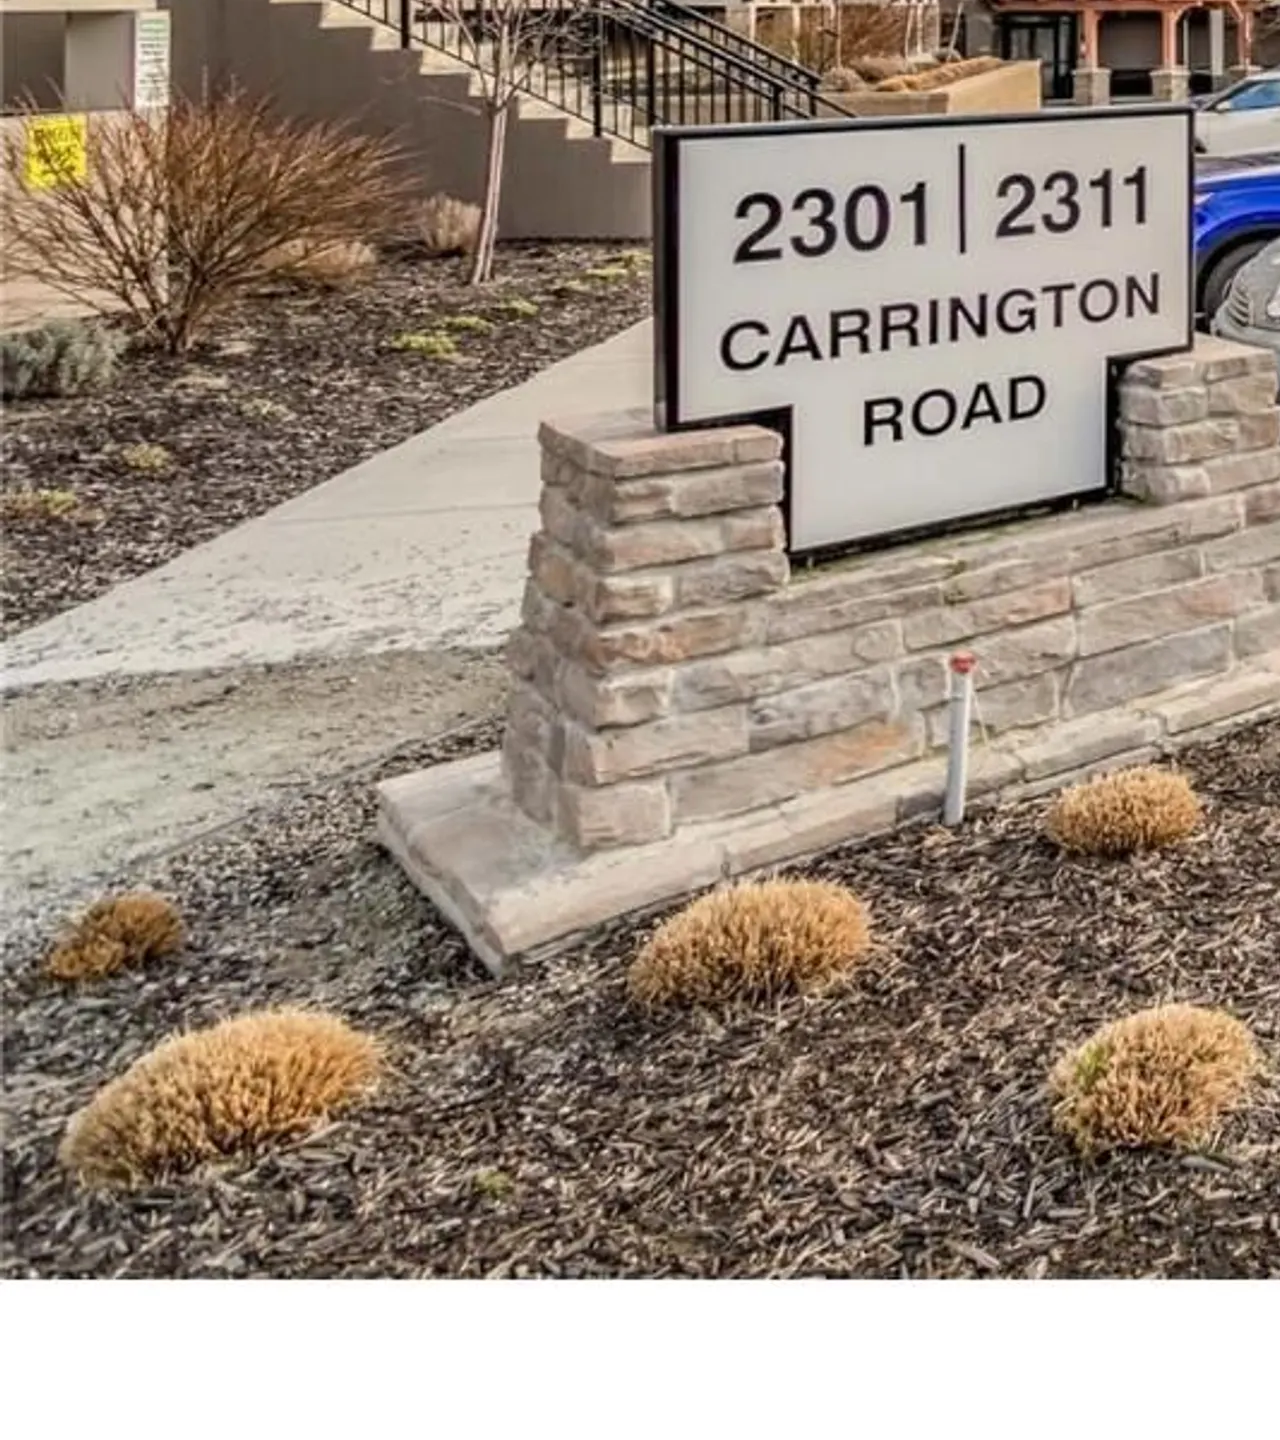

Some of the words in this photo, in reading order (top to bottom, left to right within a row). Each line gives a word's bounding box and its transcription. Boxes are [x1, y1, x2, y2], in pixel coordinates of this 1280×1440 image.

[733, 181, 927, 264] 2301
[995, 165, 1147, 239] 2311
[719, 271, 1161, 372] CARRINGTON
[862, 374, 1048, 447] ROAD
